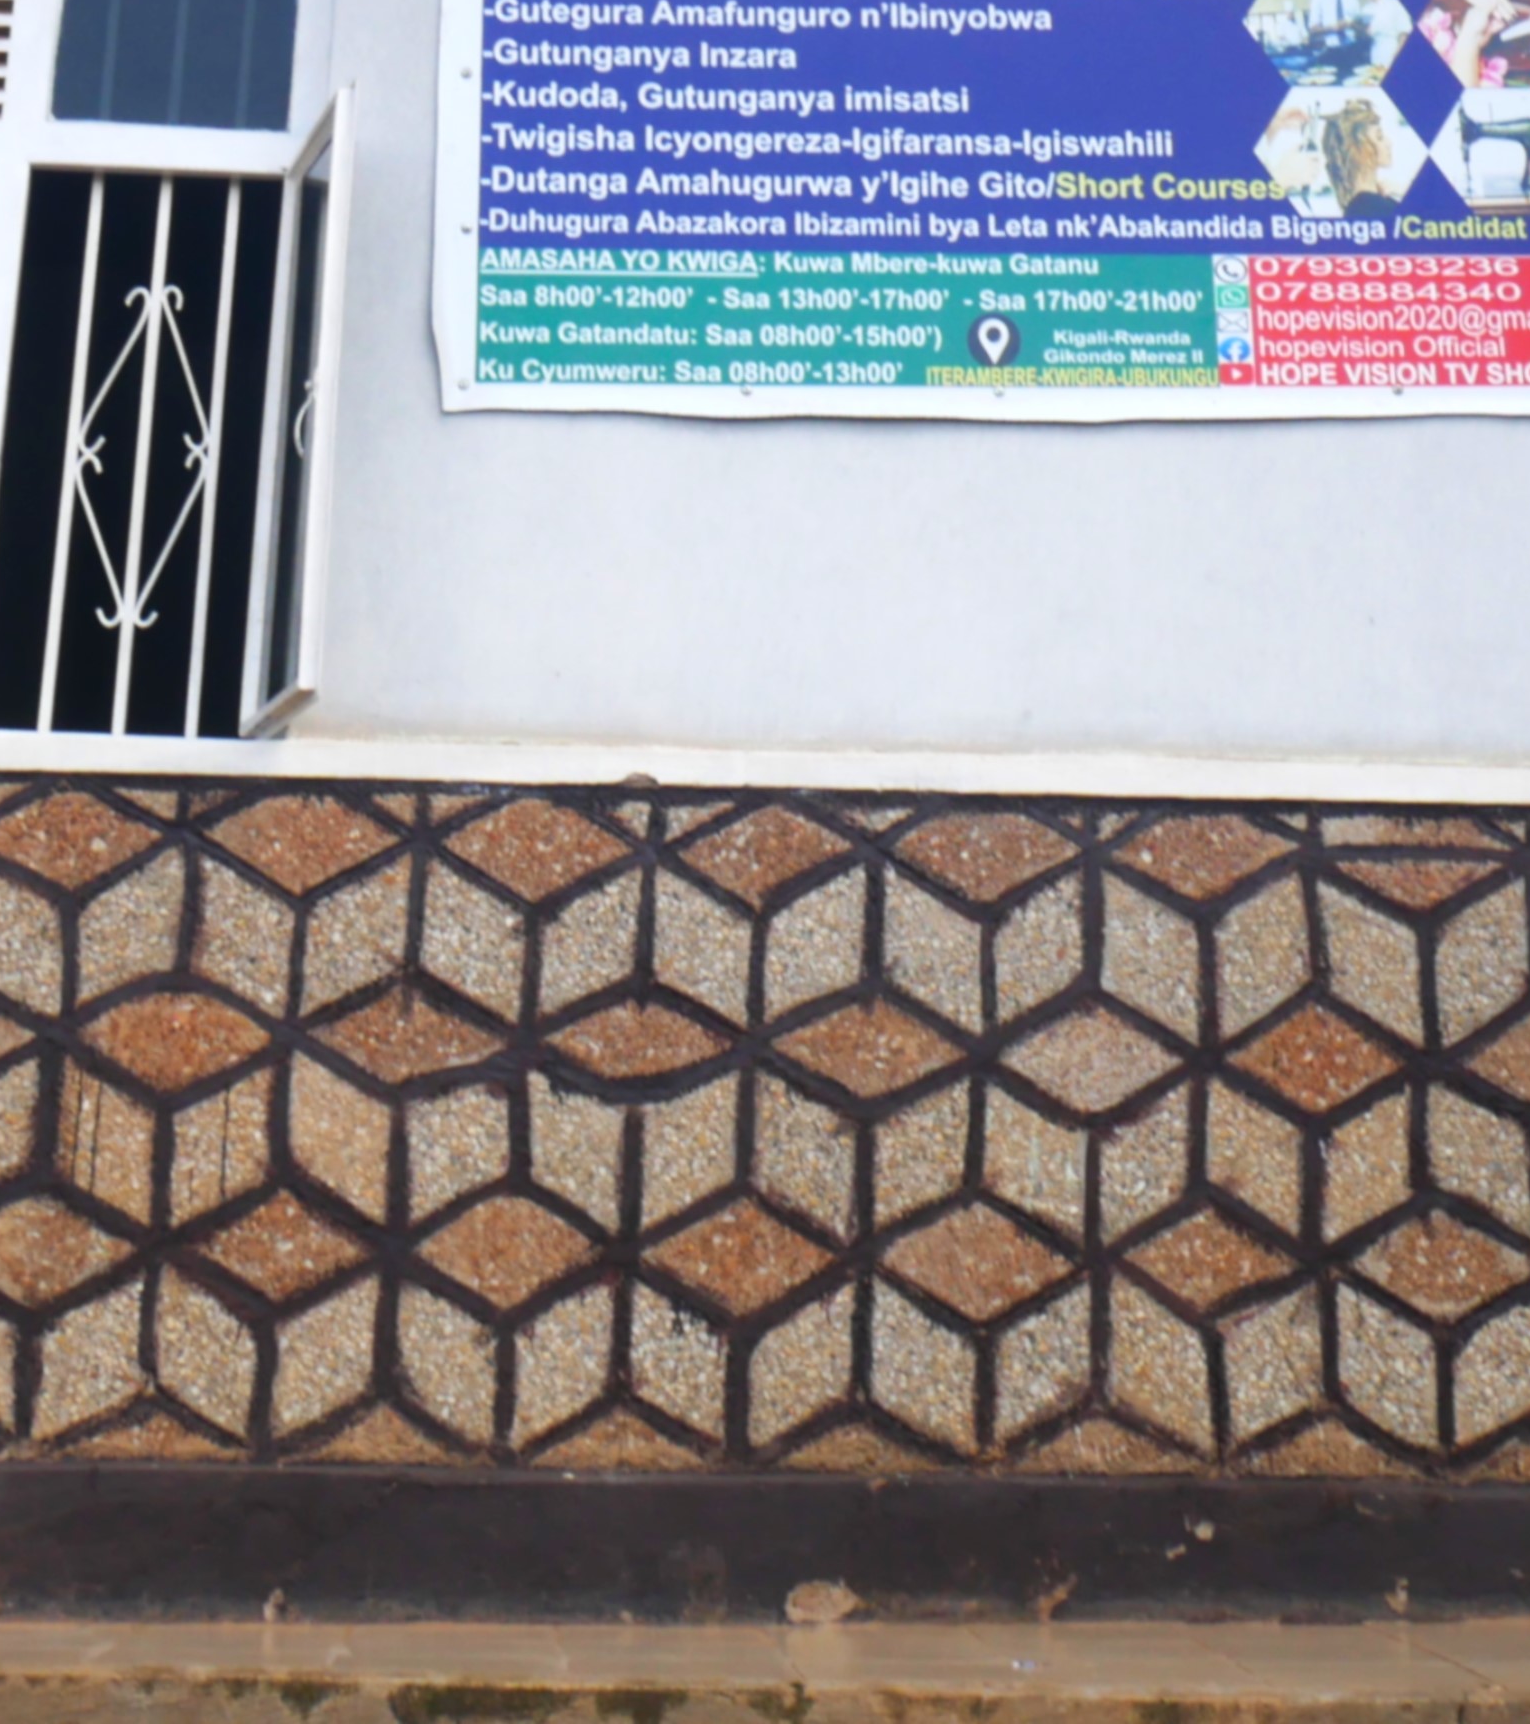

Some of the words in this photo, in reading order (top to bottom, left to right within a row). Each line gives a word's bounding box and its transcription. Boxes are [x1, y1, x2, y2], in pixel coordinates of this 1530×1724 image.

[651, 0, 851, 34] Amafunguro
[482, 38, 690, 73] -Gutunganya
[700, 42, 797, 70] Inzara
[481, 80, 628, 113] -Kudoda,
[638, 82, 835, 117] Gutunganya
[845, 85, 969, 113] imisatsi
[481, 122, 634, 157] -Twigisha
[645, 124, 1173, 162] Icyongereza-Igifaransa-Igiswahili
[480, 165, 627, 200] -Dutanga
[635, 167, 852, 202] Amahugurwa
[979, 171, 1144, 201] Gito/Short
[1153, 173, 1286, 201] Courses
[480, 207, 628, 238] -Duhugura
[636, 210, 786, 235] Abazakora
[794, 211, 920, 237] Ibizamini
[929, 213, 979, 242] bya
[988, 214, 1048, 238] Leta
[1271, 216, 1386, 244] Bigenga
[480, 248, 616, 272] AMASAHA
[623, 249, 659, 272] YO
[668, 250, 765, 274] KWIGA:
[774, 251, 844, 274] Kuwa
[852, 252, 1002, 276] Mbere-kuwa
[1009, 253, 1099, 276] Gatanu
[1254, 257, 1520, 277] 0793093236
[480, 284, 527, 307] Saa
[723, 287, 770, 310] Saa
[979, 289, 1026, 311] Saa
[1255, 282, 1522, 302] 0788884340
[480, 322, 550, 344] Kuwa
[558, 322, 697, 345] Gatandatu:
[706, 324, 752, 346] Saa
[1053, 330, 1191, 348] Kigali-Rwanda
[1043, 348, 1125, 364] Gikondo
[1259, 336, 1404, 360] hopevision
[1413, 335, 1506, 358] Official
[480, 359, 515, 382] Ku
[522, 359, 665, 385] Cyumweru:
[674, 360, 721, 383] Saa
[1260, 364, 1338, 385] HOPE
[1345, 363, 1436, 385] VISION
[1443, 363, 1478, 384] TV
